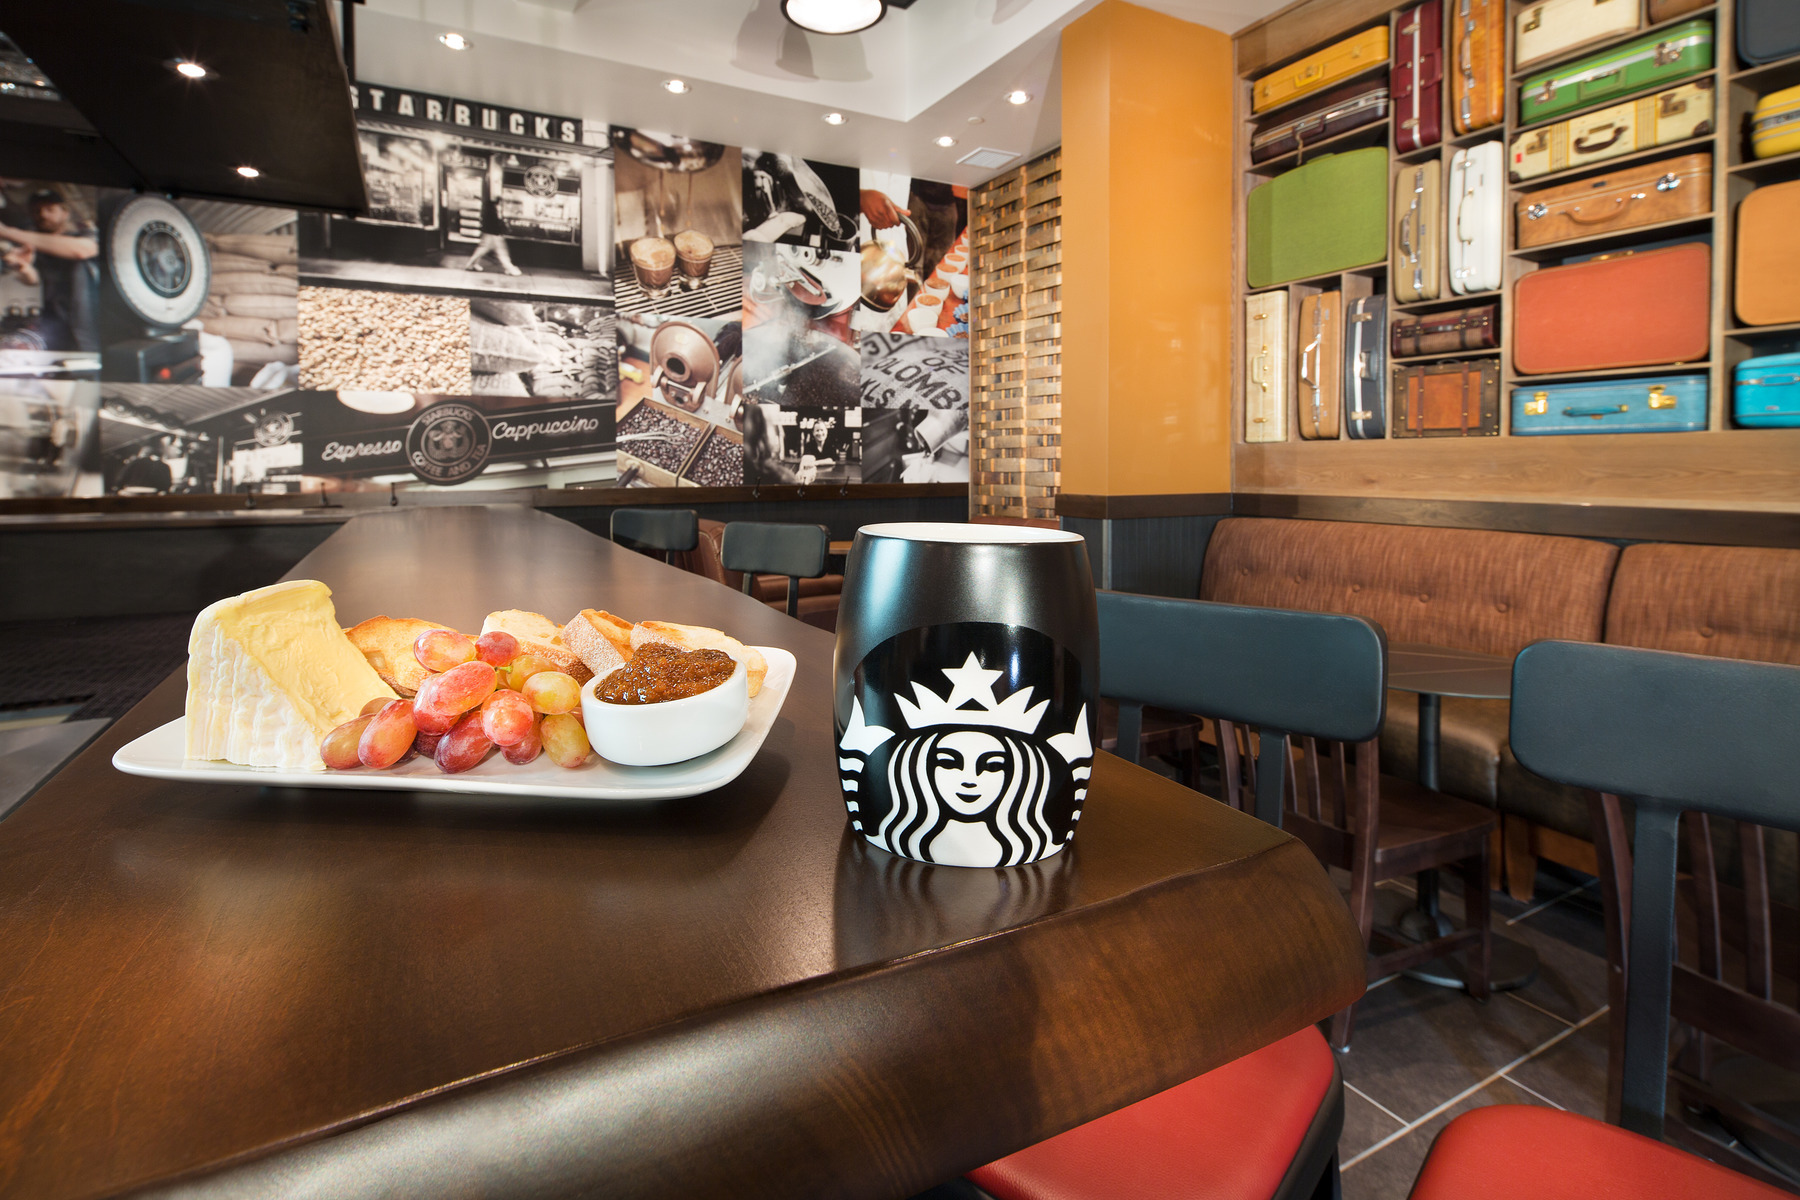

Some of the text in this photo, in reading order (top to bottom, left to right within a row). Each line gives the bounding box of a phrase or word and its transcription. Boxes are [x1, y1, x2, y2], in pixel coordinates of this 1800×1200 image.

[922, 357, 966, 374] OF
[865, 357, 968, 410] OLOMB
[421, 407, 475, 426] STARBUCKS
[492, 415, 599, 441] Cappuccino
[322, 440, 402, 462] Espresso
[412, 444, 487, 476] COFFEE AND TEA
